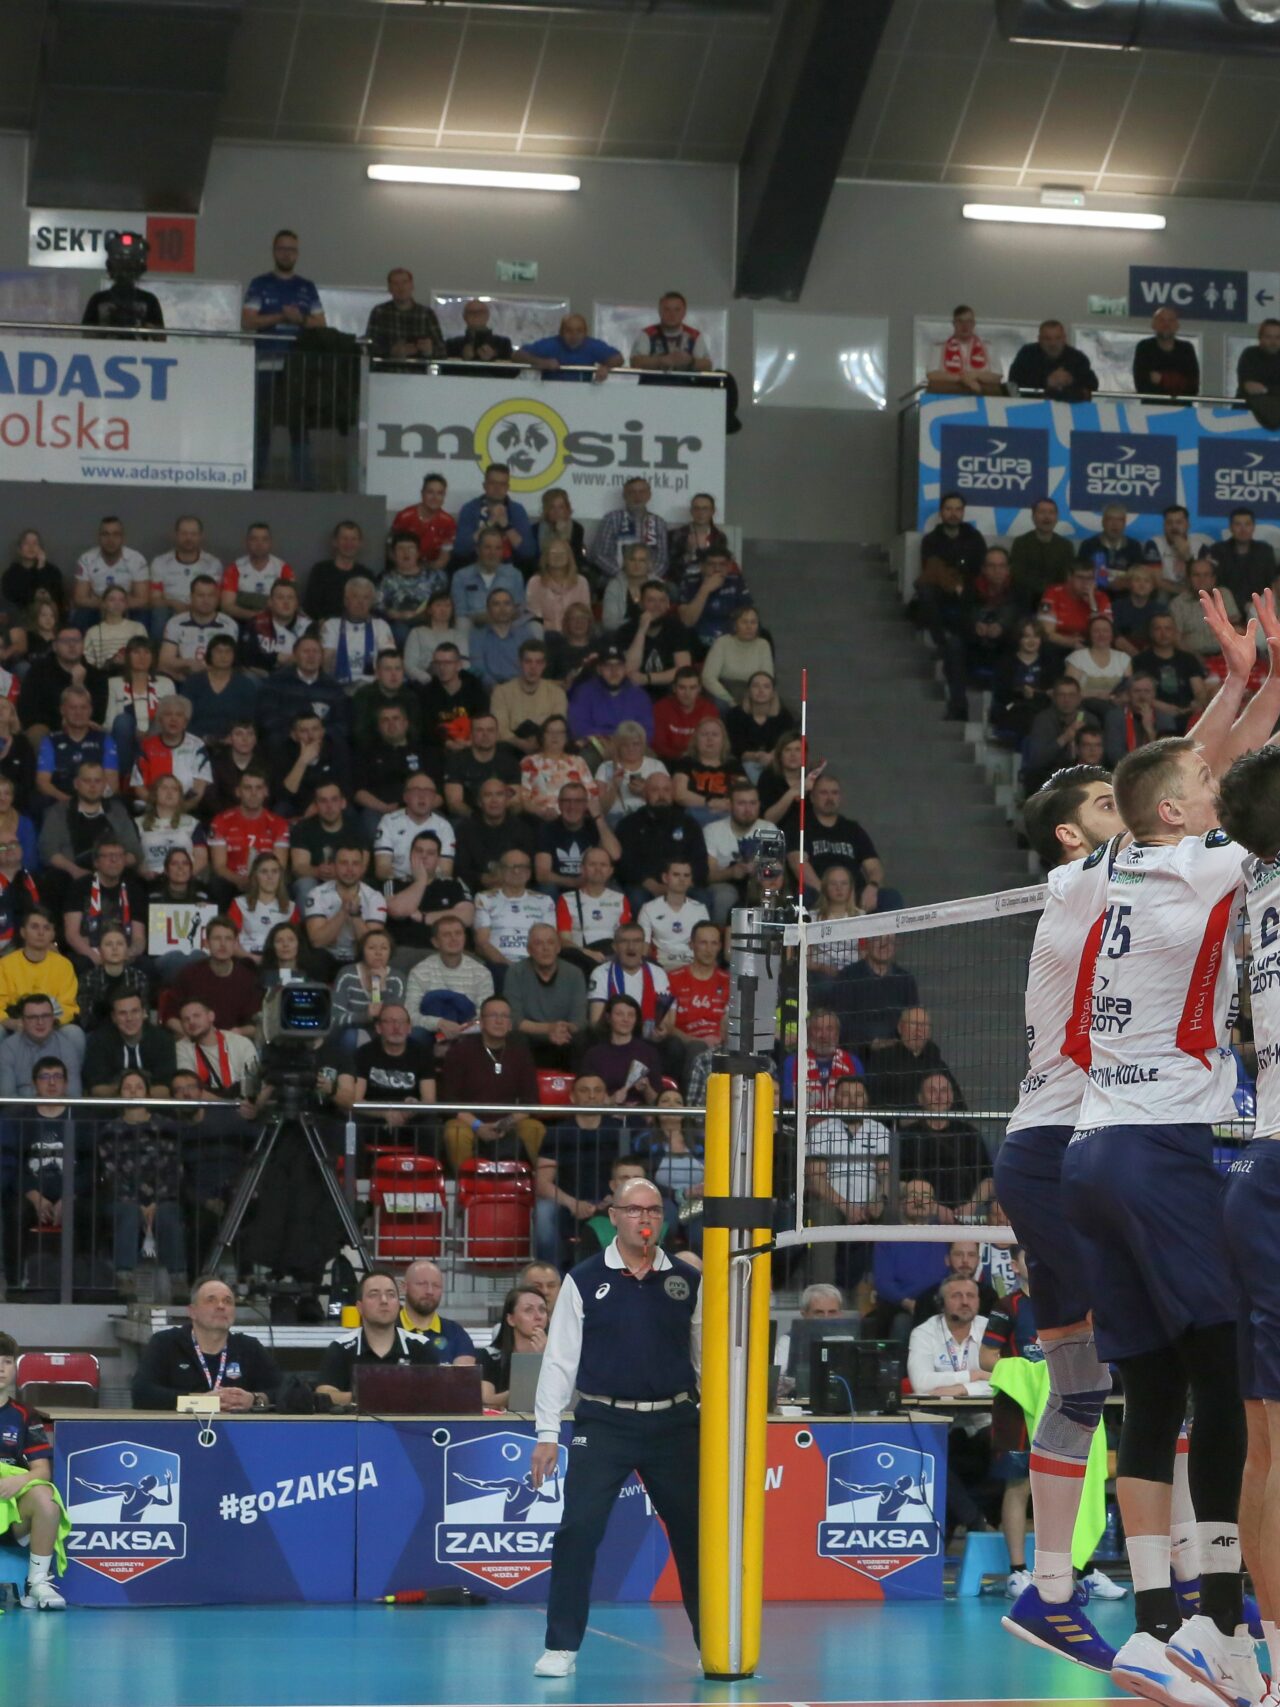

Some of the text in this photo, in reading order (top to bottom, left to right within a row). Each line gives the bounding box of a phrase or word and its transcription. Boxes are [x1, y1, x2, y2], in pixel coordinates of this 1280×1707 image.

[1141, 281, 1193, 305] WC
[81, 465, 247, 485] www.adastpolska.pl
[1099, 904, 1132, 959] 15
[692, 995, 711, 1009] 44
[219, 1461, 378, 1524] #goZAKSA
[67, 1530, 176, 1551] ZAKSA
[445, 1531, 556, 1553] ZAKSA
[826, 1529, 929, 1549] ZAKSA
[1212, 1535, 1238, 1547] 4F
